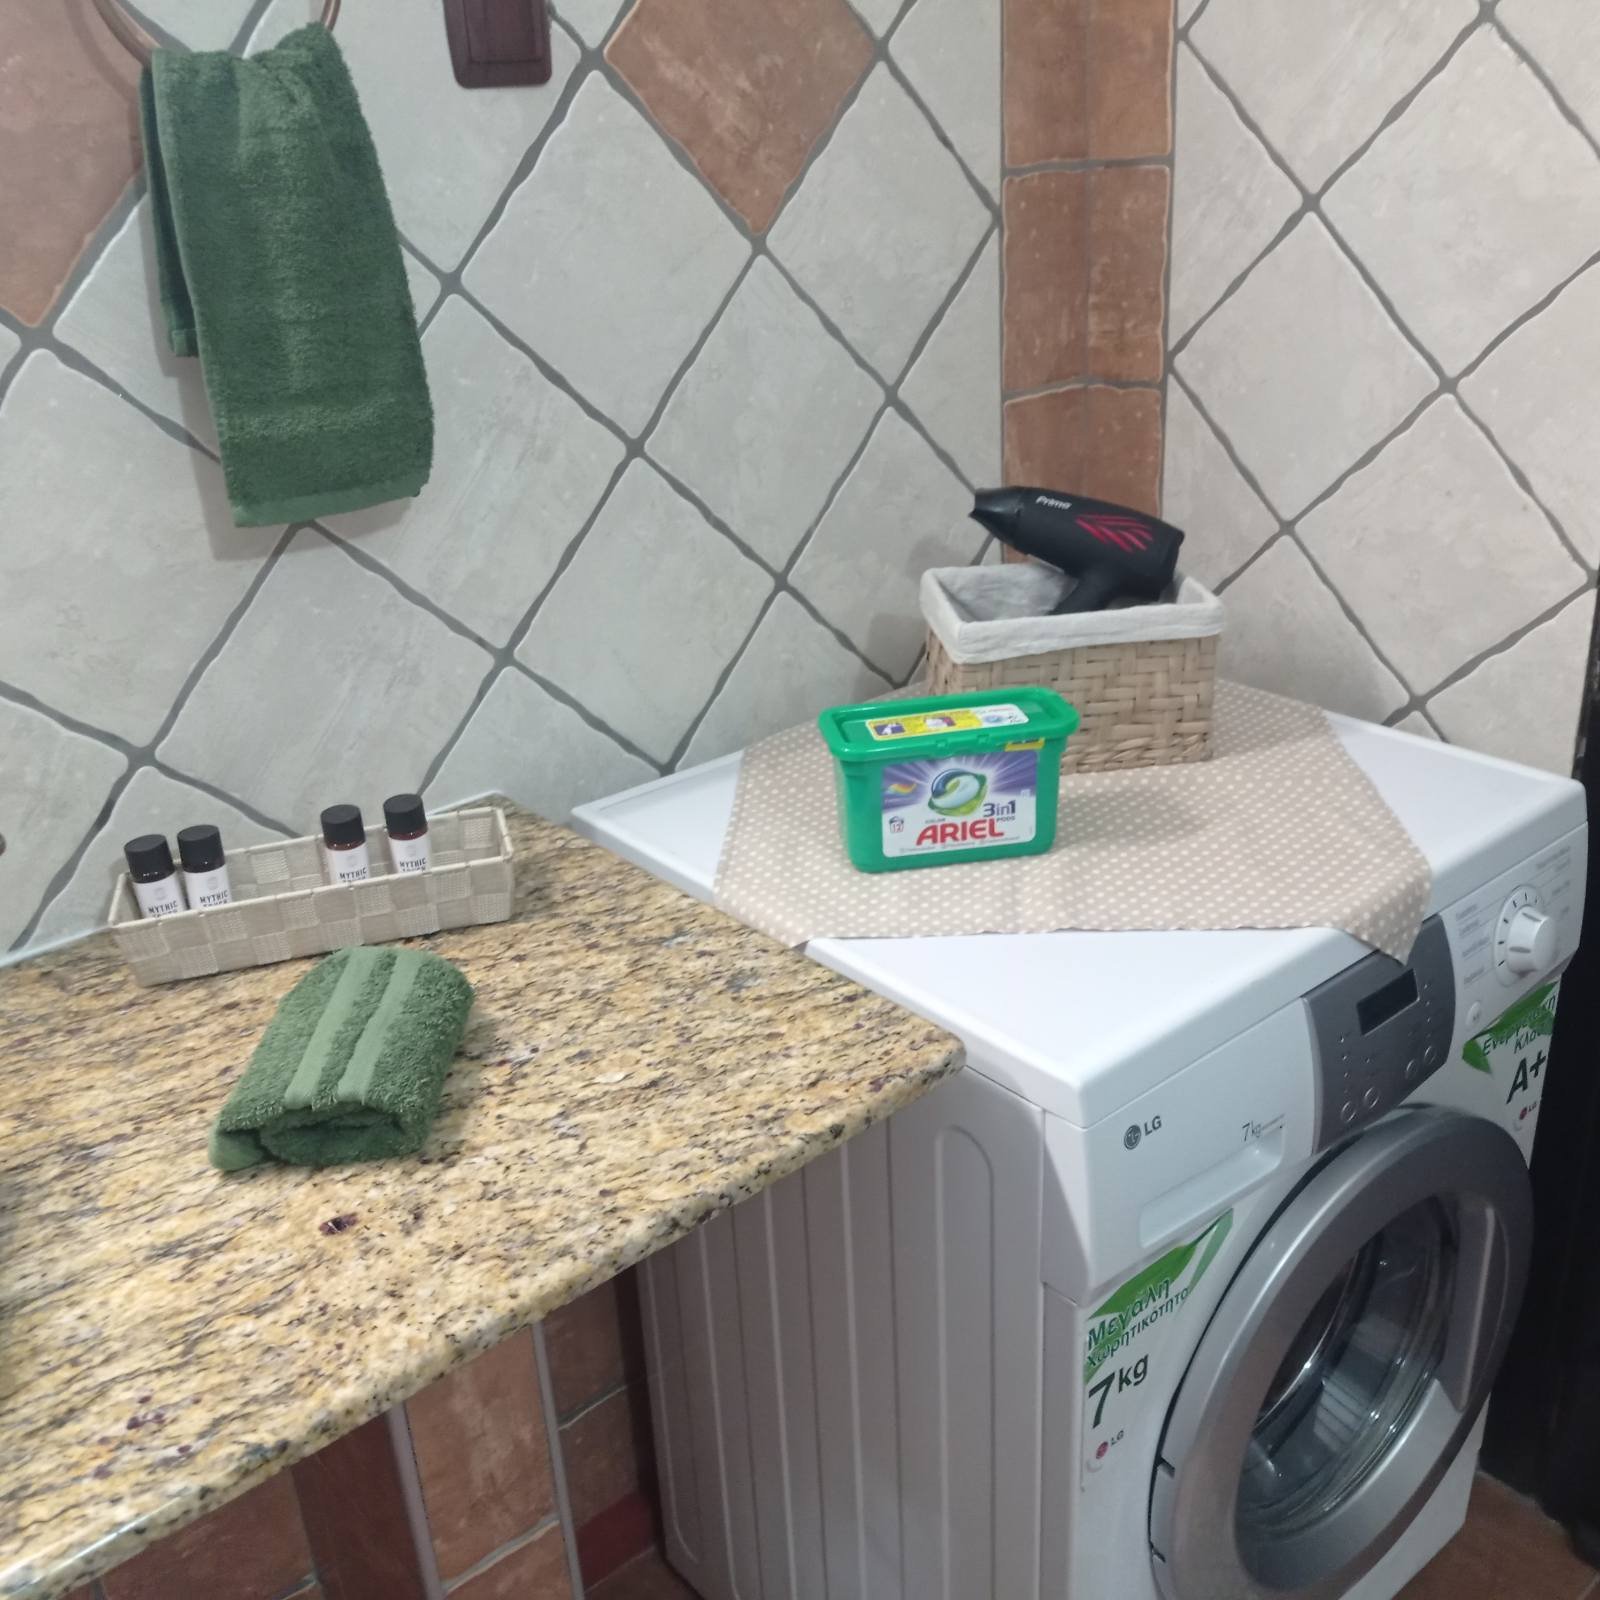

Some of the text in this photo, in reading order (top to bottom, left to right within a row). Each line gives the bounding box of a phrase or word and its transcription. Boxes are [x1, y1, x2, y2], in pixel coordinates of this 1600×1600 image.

[983, 800, 1016, 818] 3in1
[916, 818, 1004, 846] ARIEL
[399, 857, 427, 869] MYTHIC
[339, 867, 367, 880] MYTHIC
[199, 889, 228, 904] MYTHIC
[148, 900, 178, 914] MYTHIC
[1506, 1049, 1547, 1105] A+
[1143, 1115, 1162, 1136] LG
[1110, 1429, 1125, 1446] LG
